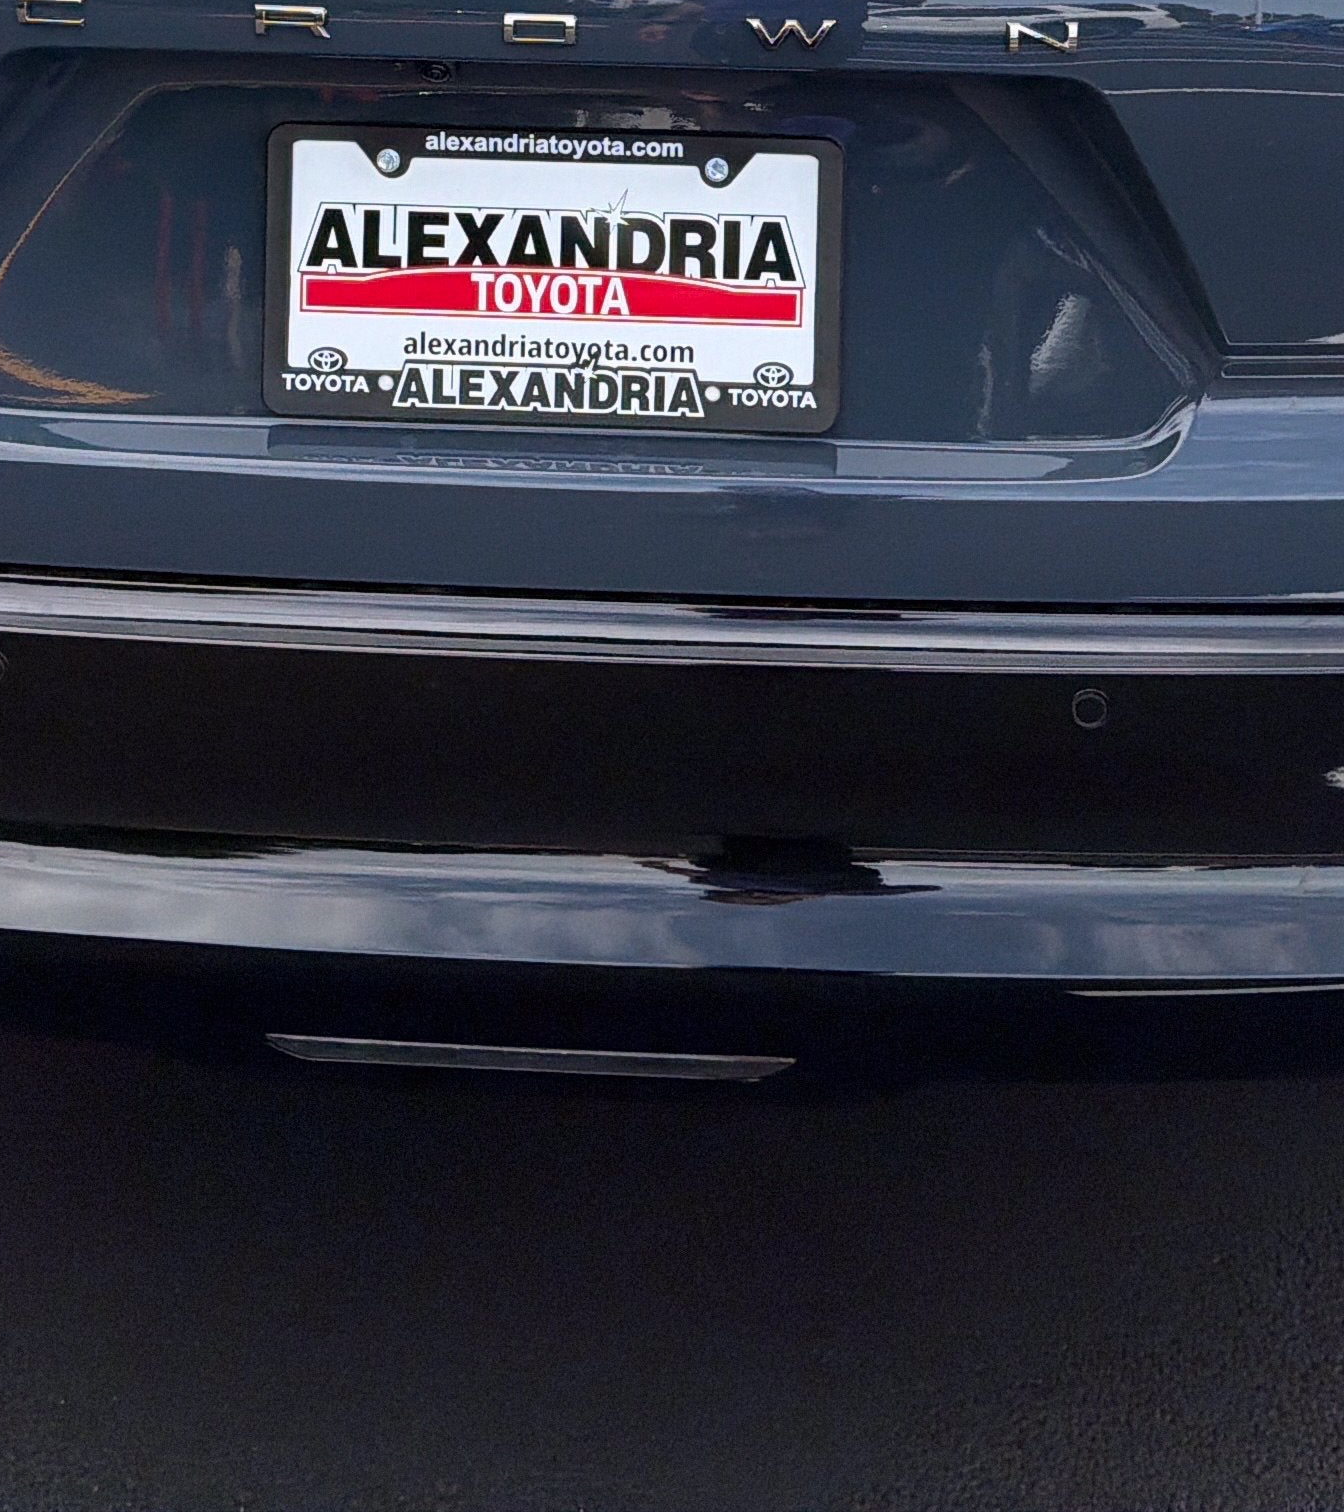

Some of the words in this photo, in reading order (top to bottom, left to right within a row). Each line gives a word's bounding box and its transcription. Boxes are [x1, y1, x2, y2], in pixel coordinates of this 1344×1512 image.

[424, 131, 685, 160] alexandriatoyota.com
[304, 205, 799, 283] ALEXANDRIA
[469, 272, 631, 316] TOYOTA
[403, 332, 695, 366] alexandriatoyota.com
[281, 372, 370, 394] TOYOTA
[393, 364, 704, 417] ALEXANDRIA
[728, 387, 817, 409] TOYOTA
